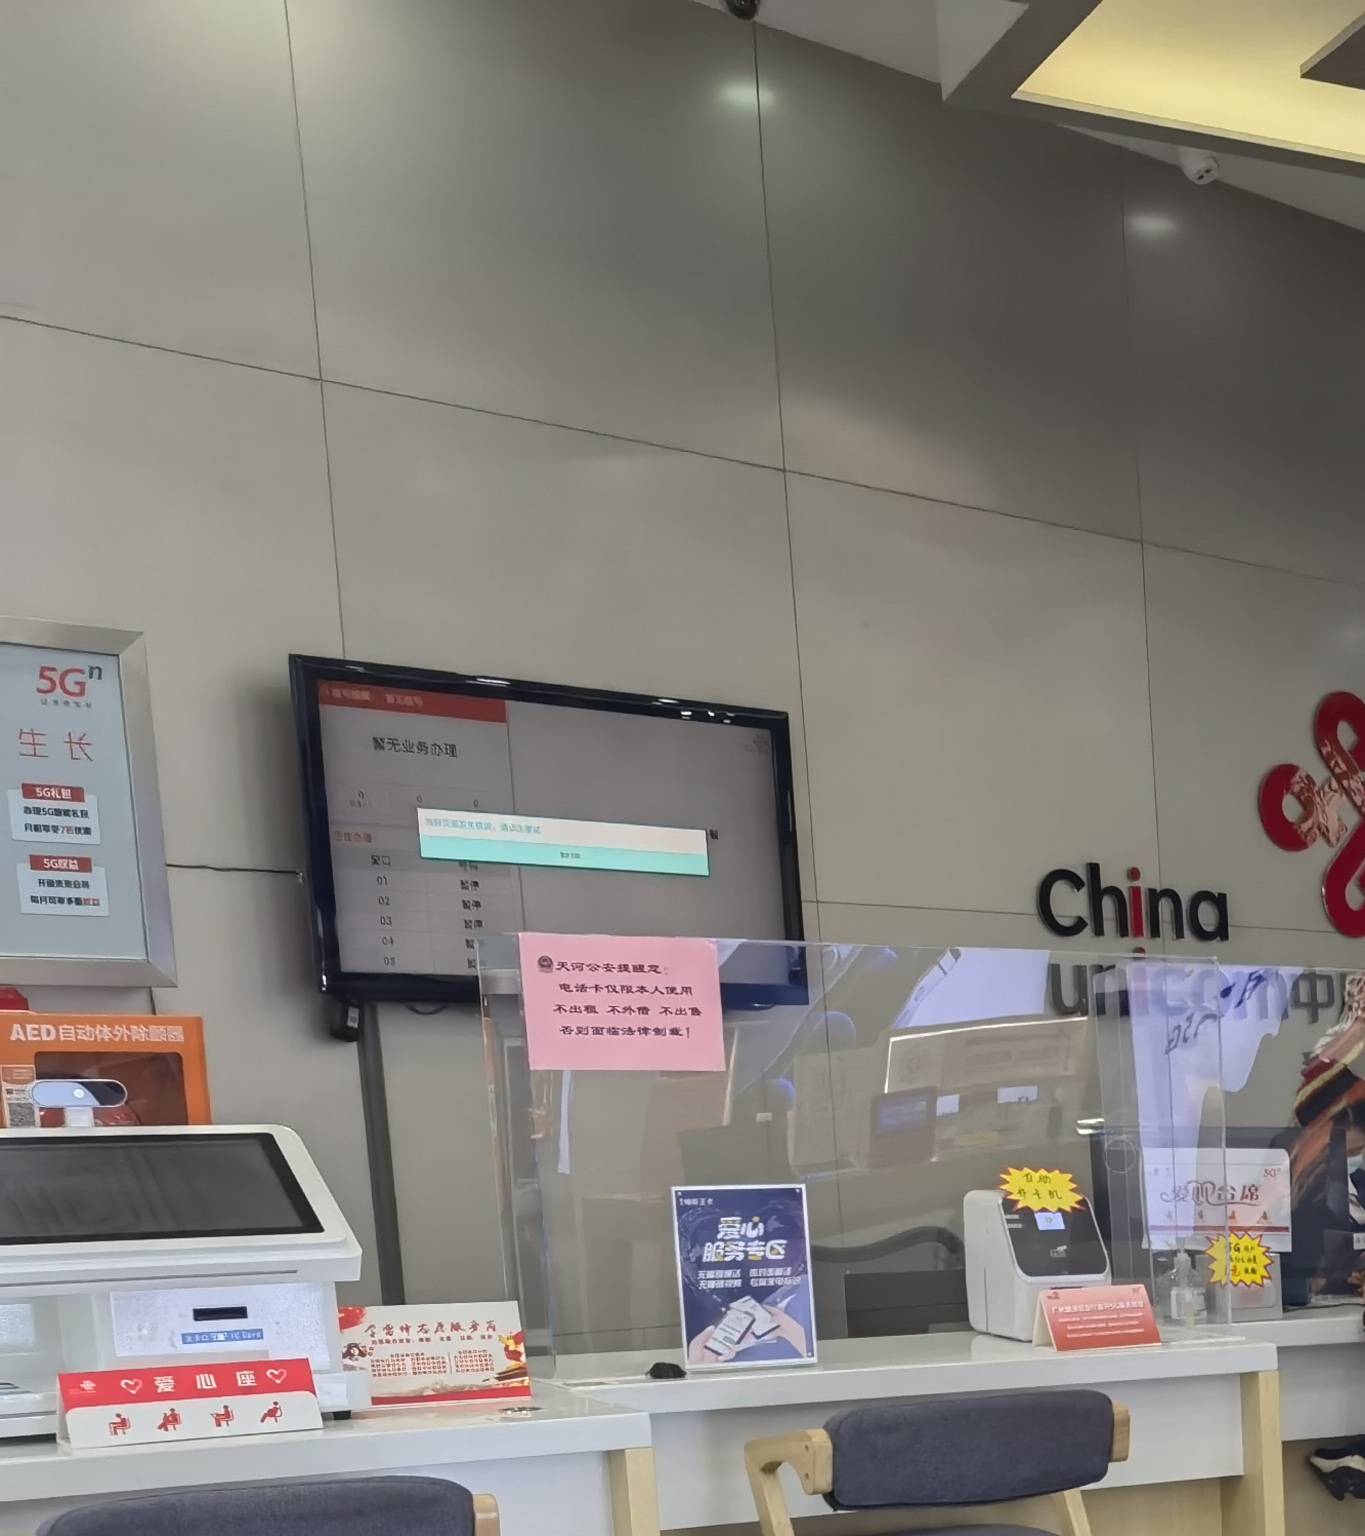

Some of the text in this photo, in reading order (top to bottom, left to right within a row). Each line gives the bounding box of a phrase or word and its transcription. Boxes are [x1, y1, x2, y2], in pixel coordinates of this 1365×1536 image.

[19, 728, 94, 762] 生长
[372, 736, 458, 758] 暂无业务办理
[376, 875, 388, 886] 01
[378, 895, 391, 906] 02
[1036, 862, 1230, 942] China
[380, 915, 393, 927] 03
[382, 936, 394, 947] 04
[559, 983, 693, 996] 电话卡仅限本人使用
[553, 1004, 599, 1016] 不出租
[717, 1216, 765, 1240] 爱心
[702, 1239, 788, 1262] 服务专区
[153, 1370, 258, 1393] 爱心座
